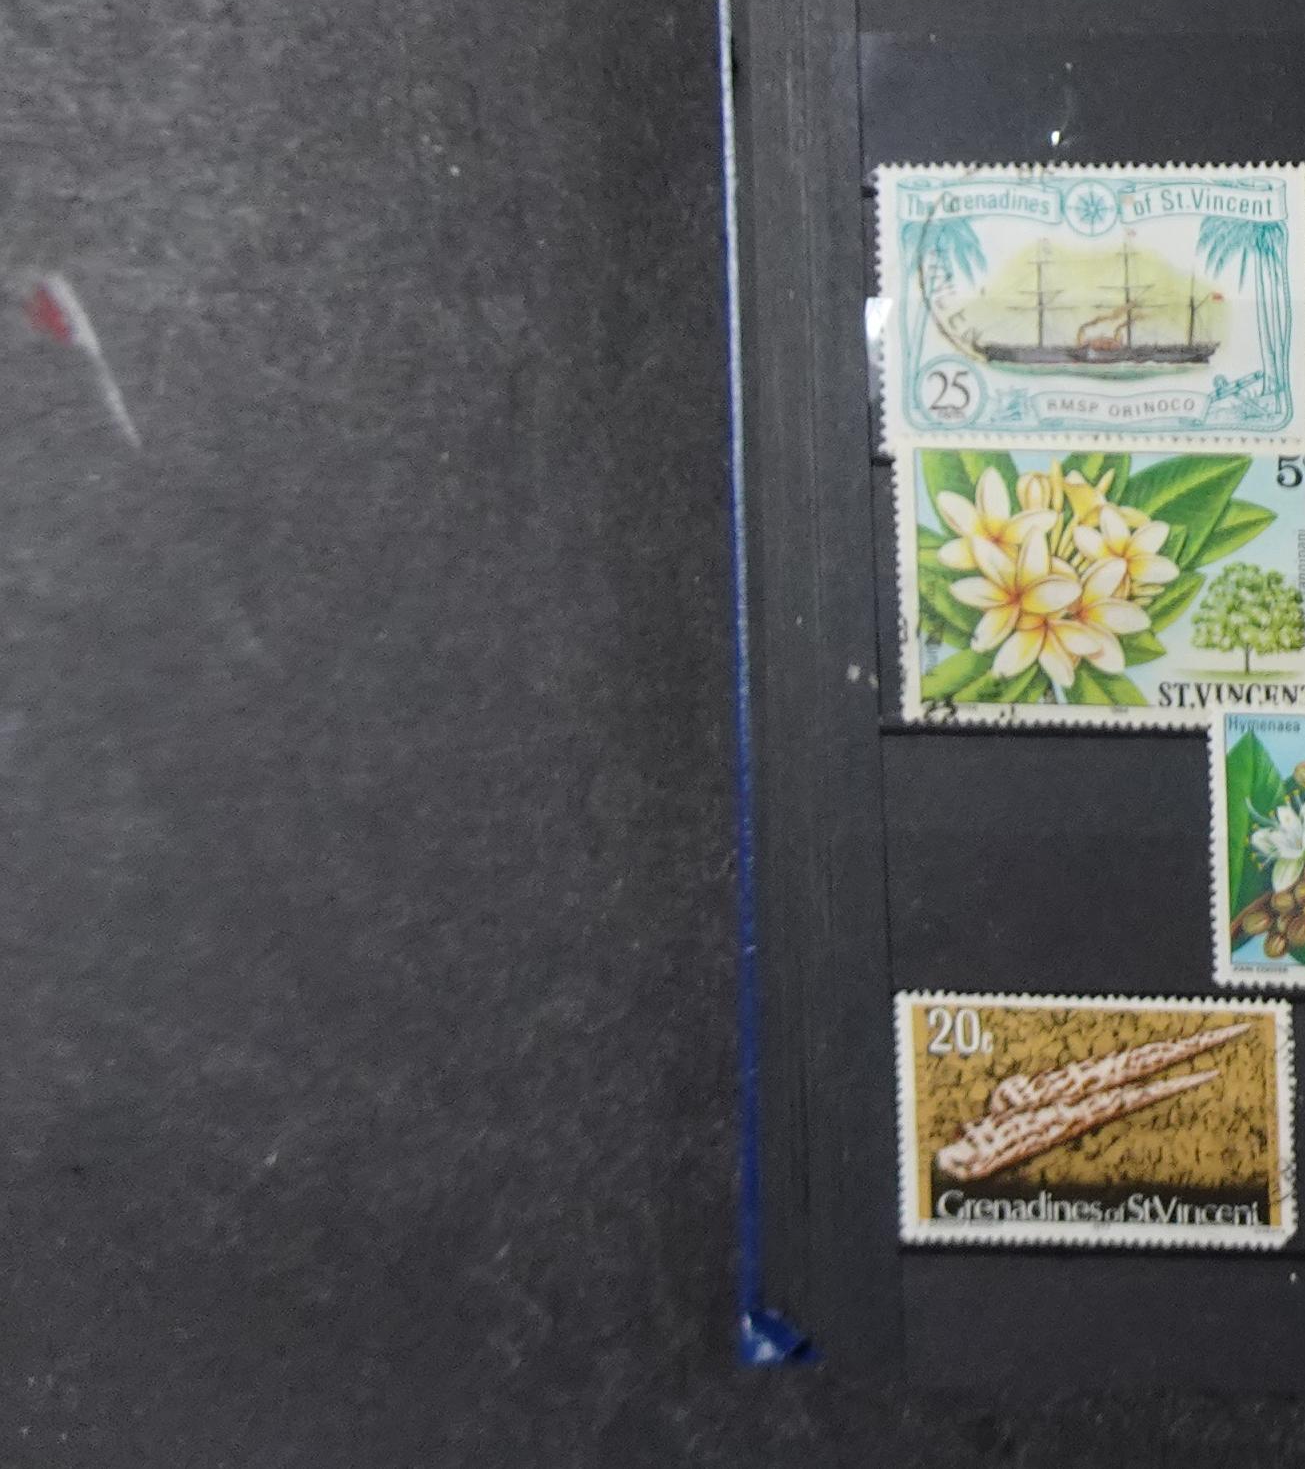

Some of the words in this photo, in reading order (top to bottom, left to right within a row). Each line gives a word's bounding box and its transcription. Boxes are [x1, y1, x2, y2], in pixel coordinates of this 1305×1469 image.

[941, 187, 1050, 216] Grenadines
[1134, 191, 1152, 217] of
[926, 370, 971, 411] 25
[1047, 397, 1099, 414] RMSP
[1107, 397, 1196, 418] ORINOCO
[1228, 715, 1301, 734] Hymenaea
[927, 1006, 993, 1057] 20c
[937, 1189, 1101, 1223] Grenadines
